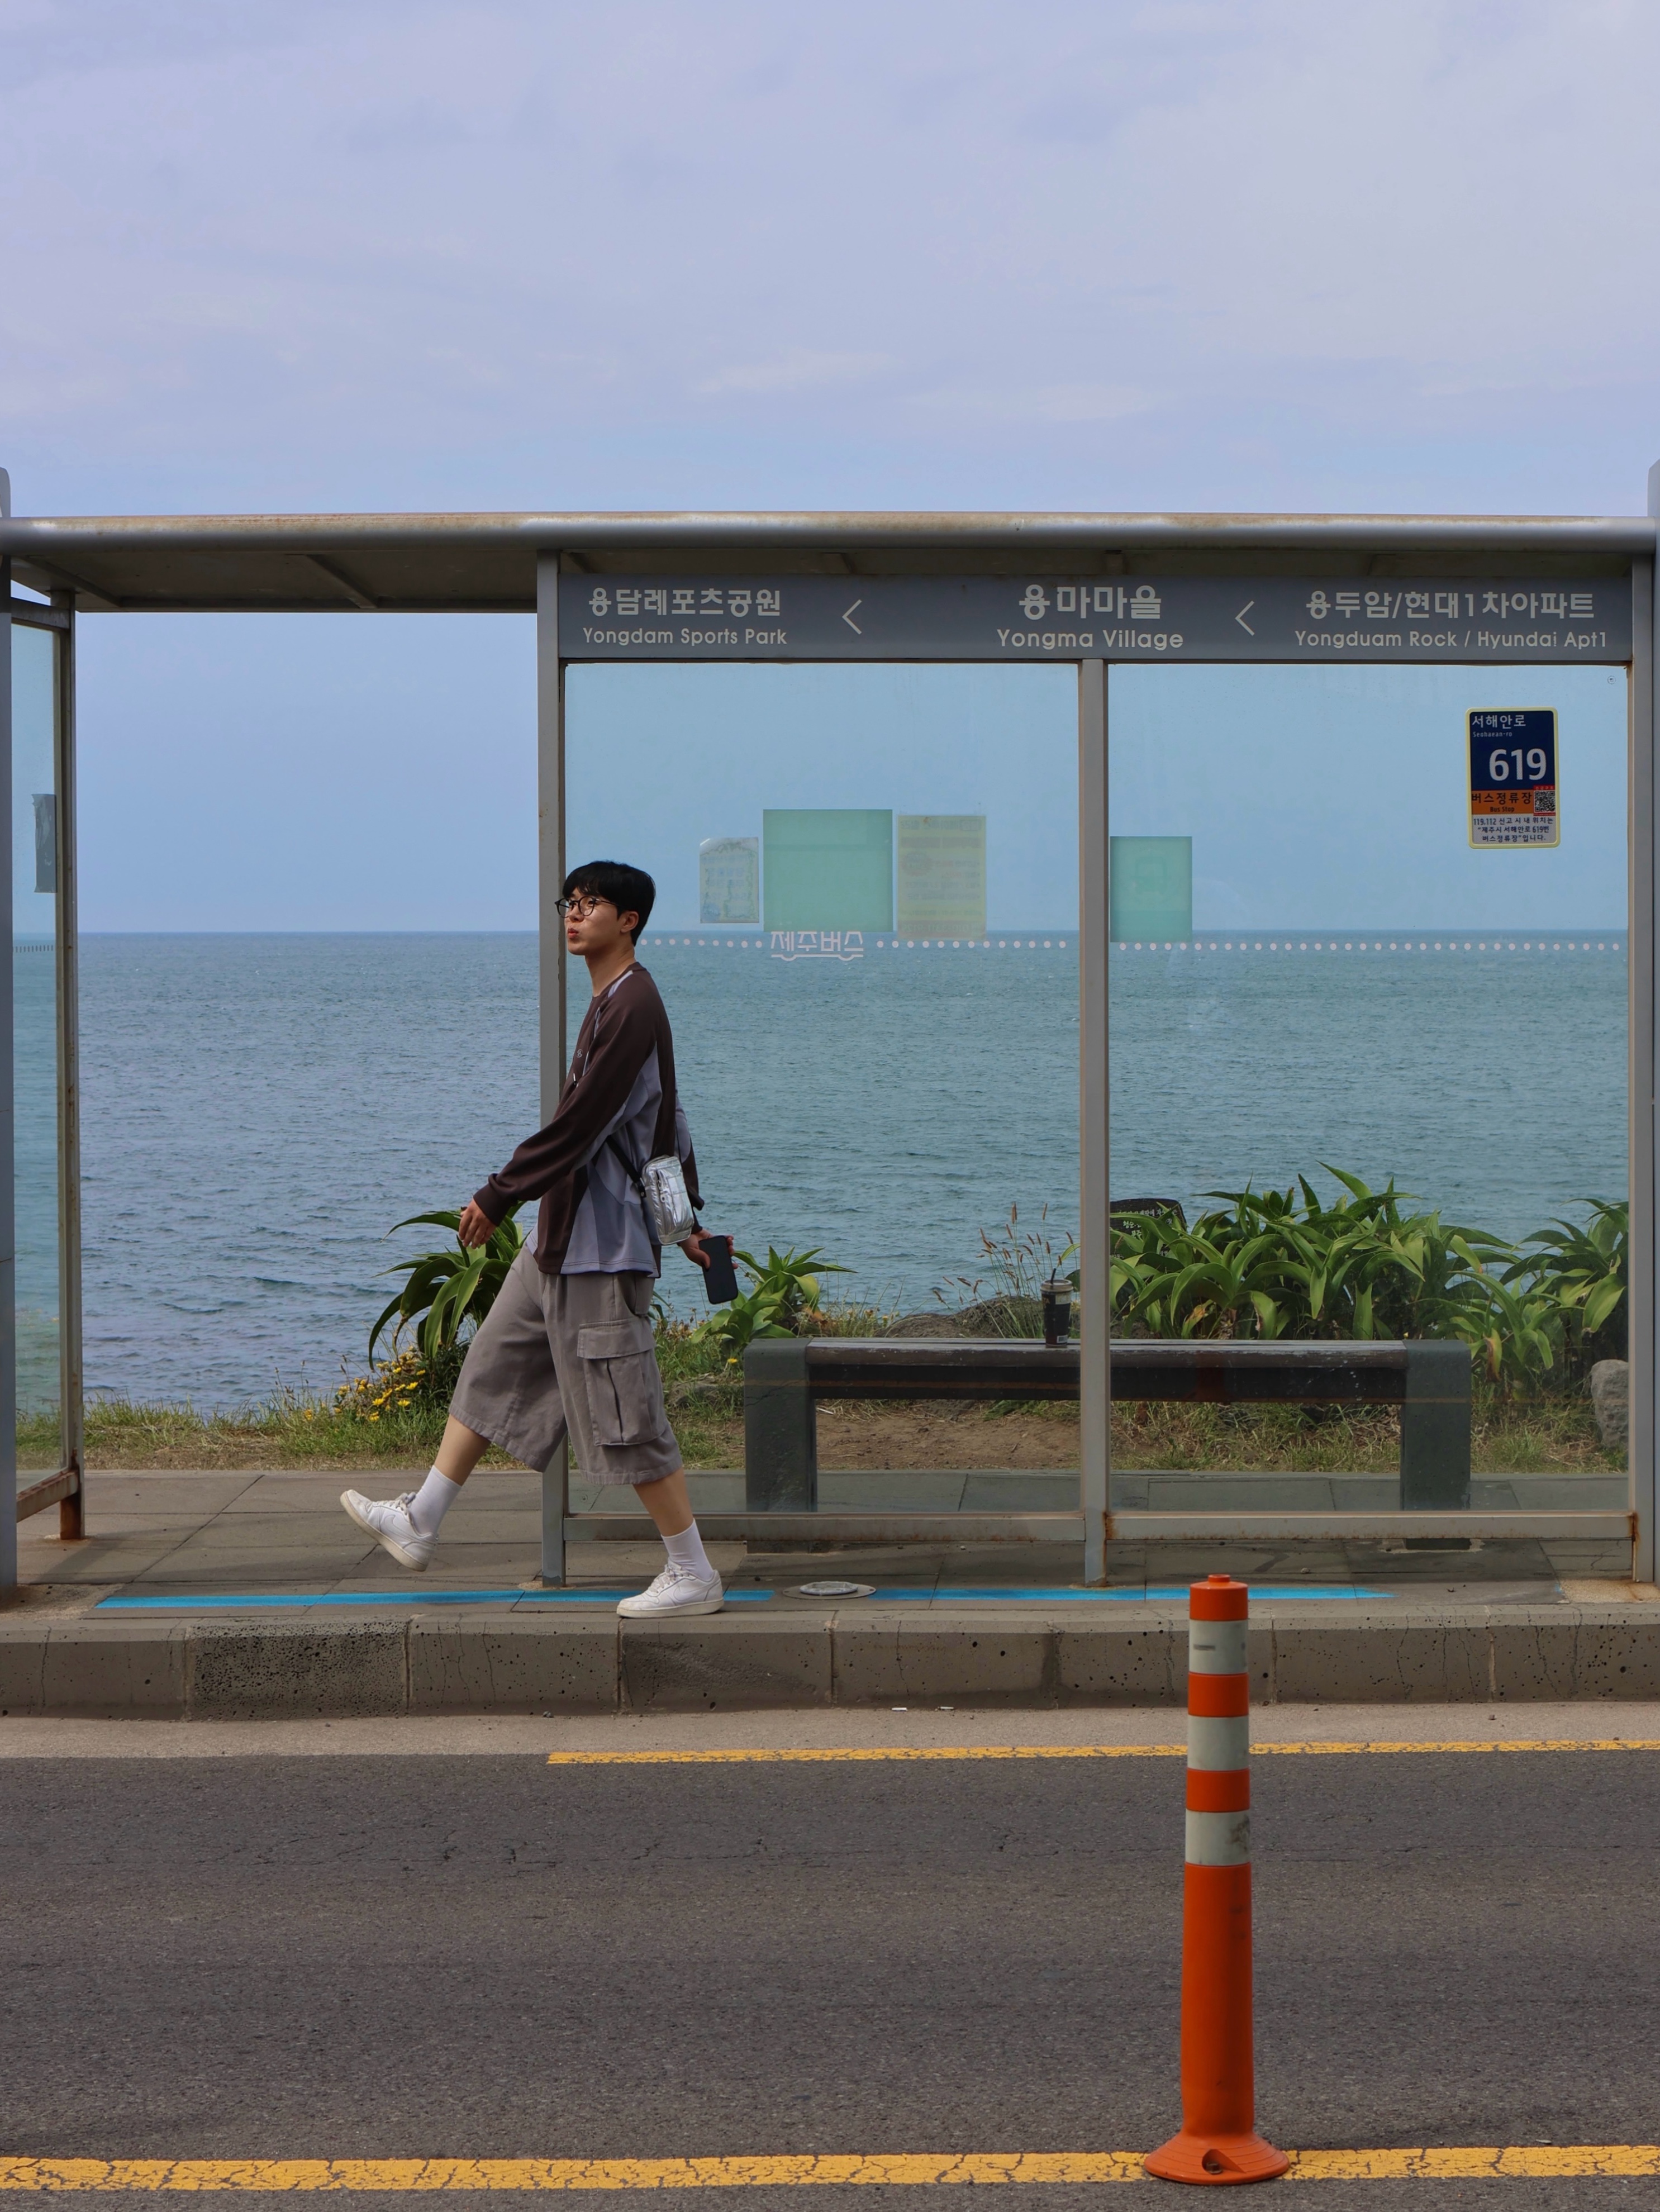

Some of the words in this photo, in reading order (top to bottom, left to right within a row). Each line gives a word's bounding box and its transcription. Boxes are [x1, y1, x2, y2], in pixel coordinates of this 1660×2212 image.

[589, 588, 780, 617] 용담레포츠공원
[1019, 584, 1161, 620] 용마마을
[1306, 591, 1594, 619] 용두암/현대1차아파트
[583, 627, 673, 646] Yongdam
[681, 628, 738, 646] Sports
[745, 629, 787, 644] Park
[997, 629, 1093, 650] Yongma
[1103, 630, 1183, 651] Village
[1295, 631, 1401, 649] Yongduam
[1410, 631, 1457, 646] Rock
[1478, 631, 1556, 649] Hyundai
[1564, 631, 1605, 649] Apt1
[1472, 715, 1526, 729] 서해안로
[1489, 748, 1547, 781] 619
[1472, 792, 1532, 805] 버스정류장
[771, 931, 864, 952] 제주버스
